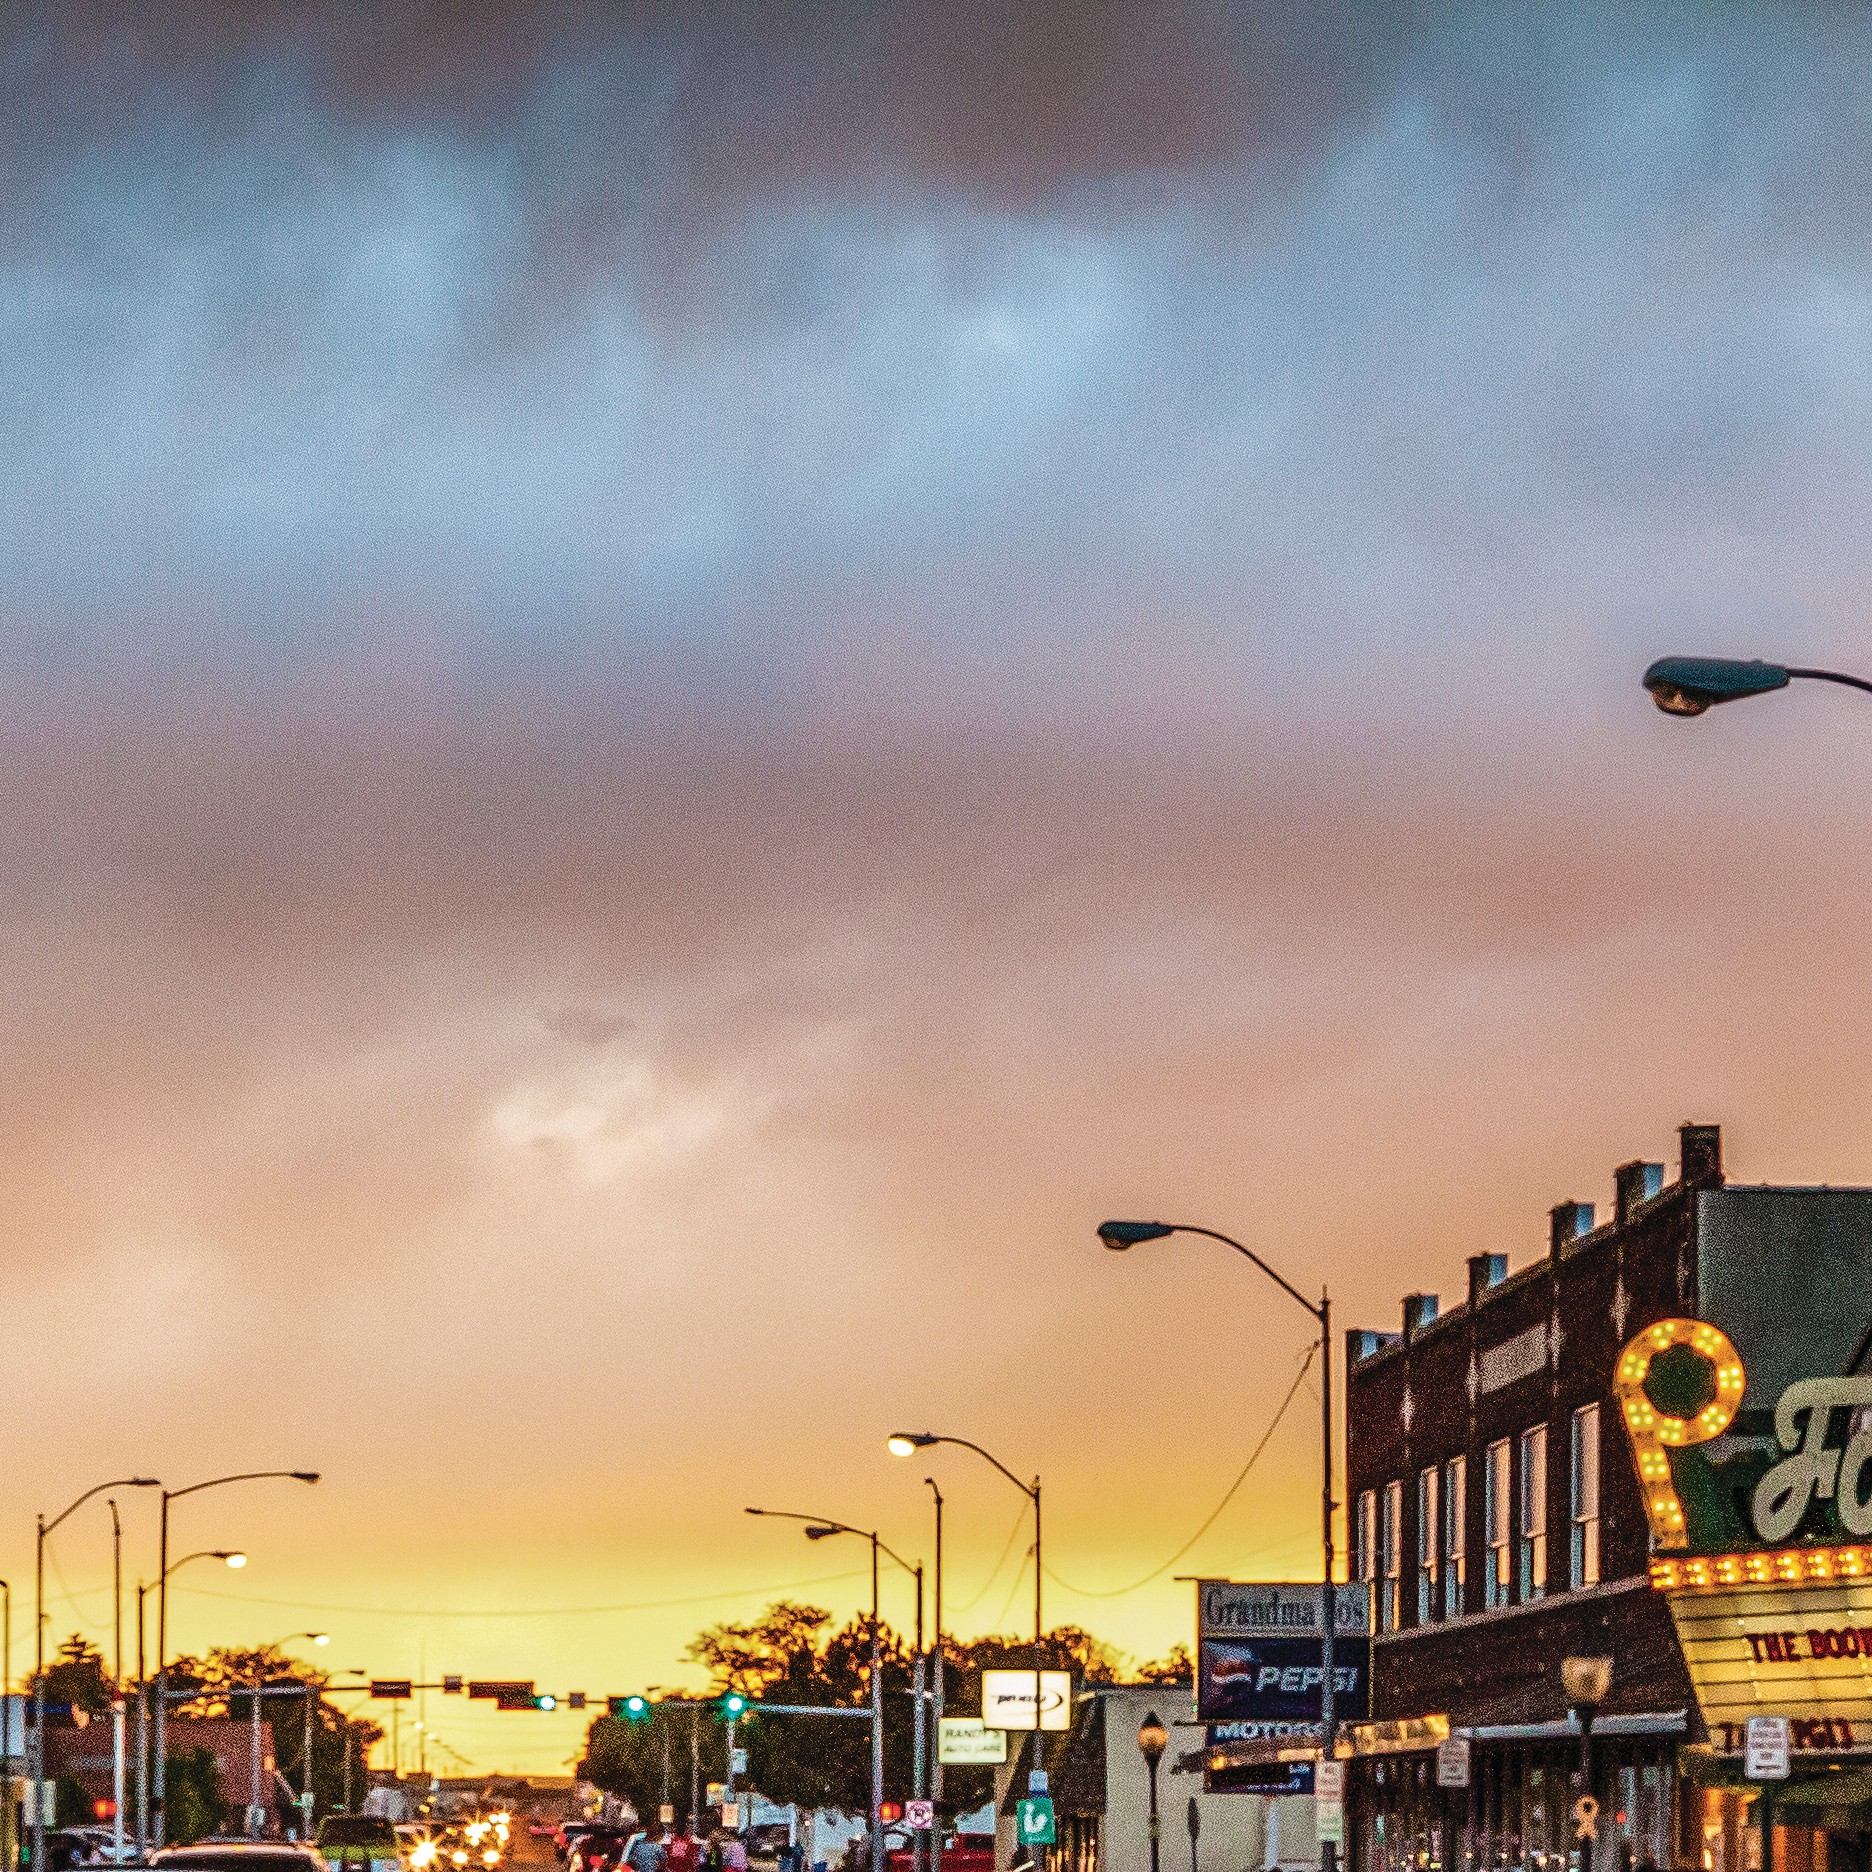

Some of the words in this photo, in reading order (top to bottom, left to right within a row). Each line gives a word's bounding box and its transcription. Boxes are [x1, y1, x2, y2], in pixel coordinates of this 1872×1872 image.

[1206, 1588, 1316, 1626] Grandma
[1745, 1632, 1801, 1662] THE
[1255, 1666, 1357, 1692] PEPSI
